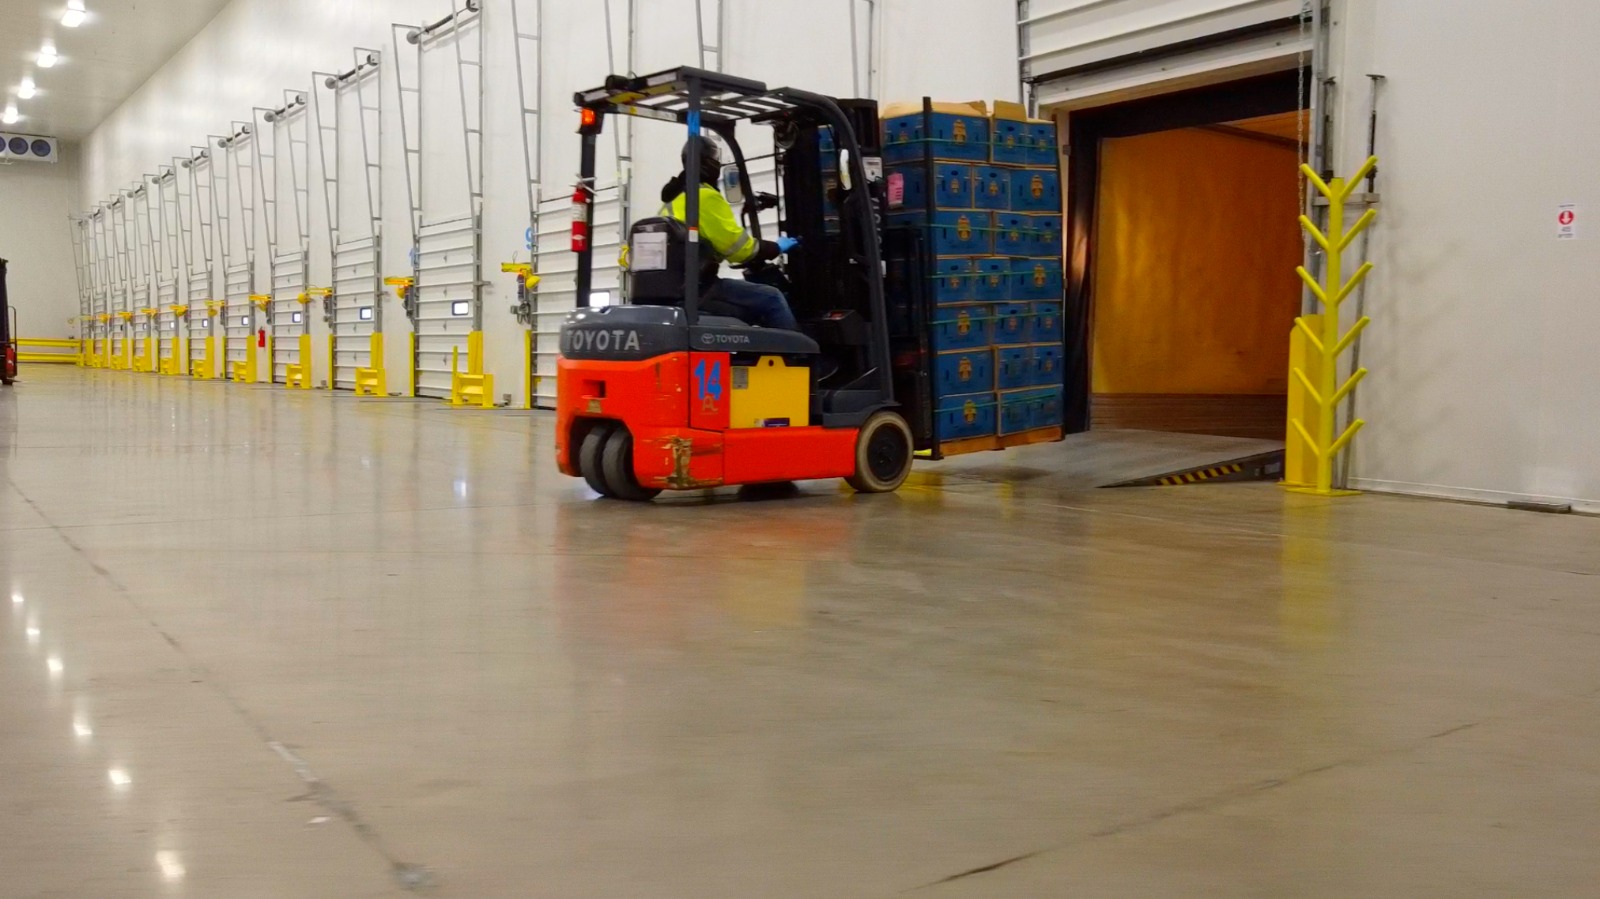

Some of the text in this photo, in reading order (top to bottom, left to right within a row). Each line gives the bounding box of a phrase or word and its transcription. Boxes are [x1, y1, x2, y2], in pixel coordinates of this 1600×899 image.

[566, 329, 640, 351] TOYOTA
[715, 334, 750, 344] TOYOTA
[694, 359, 722, 400] 14
